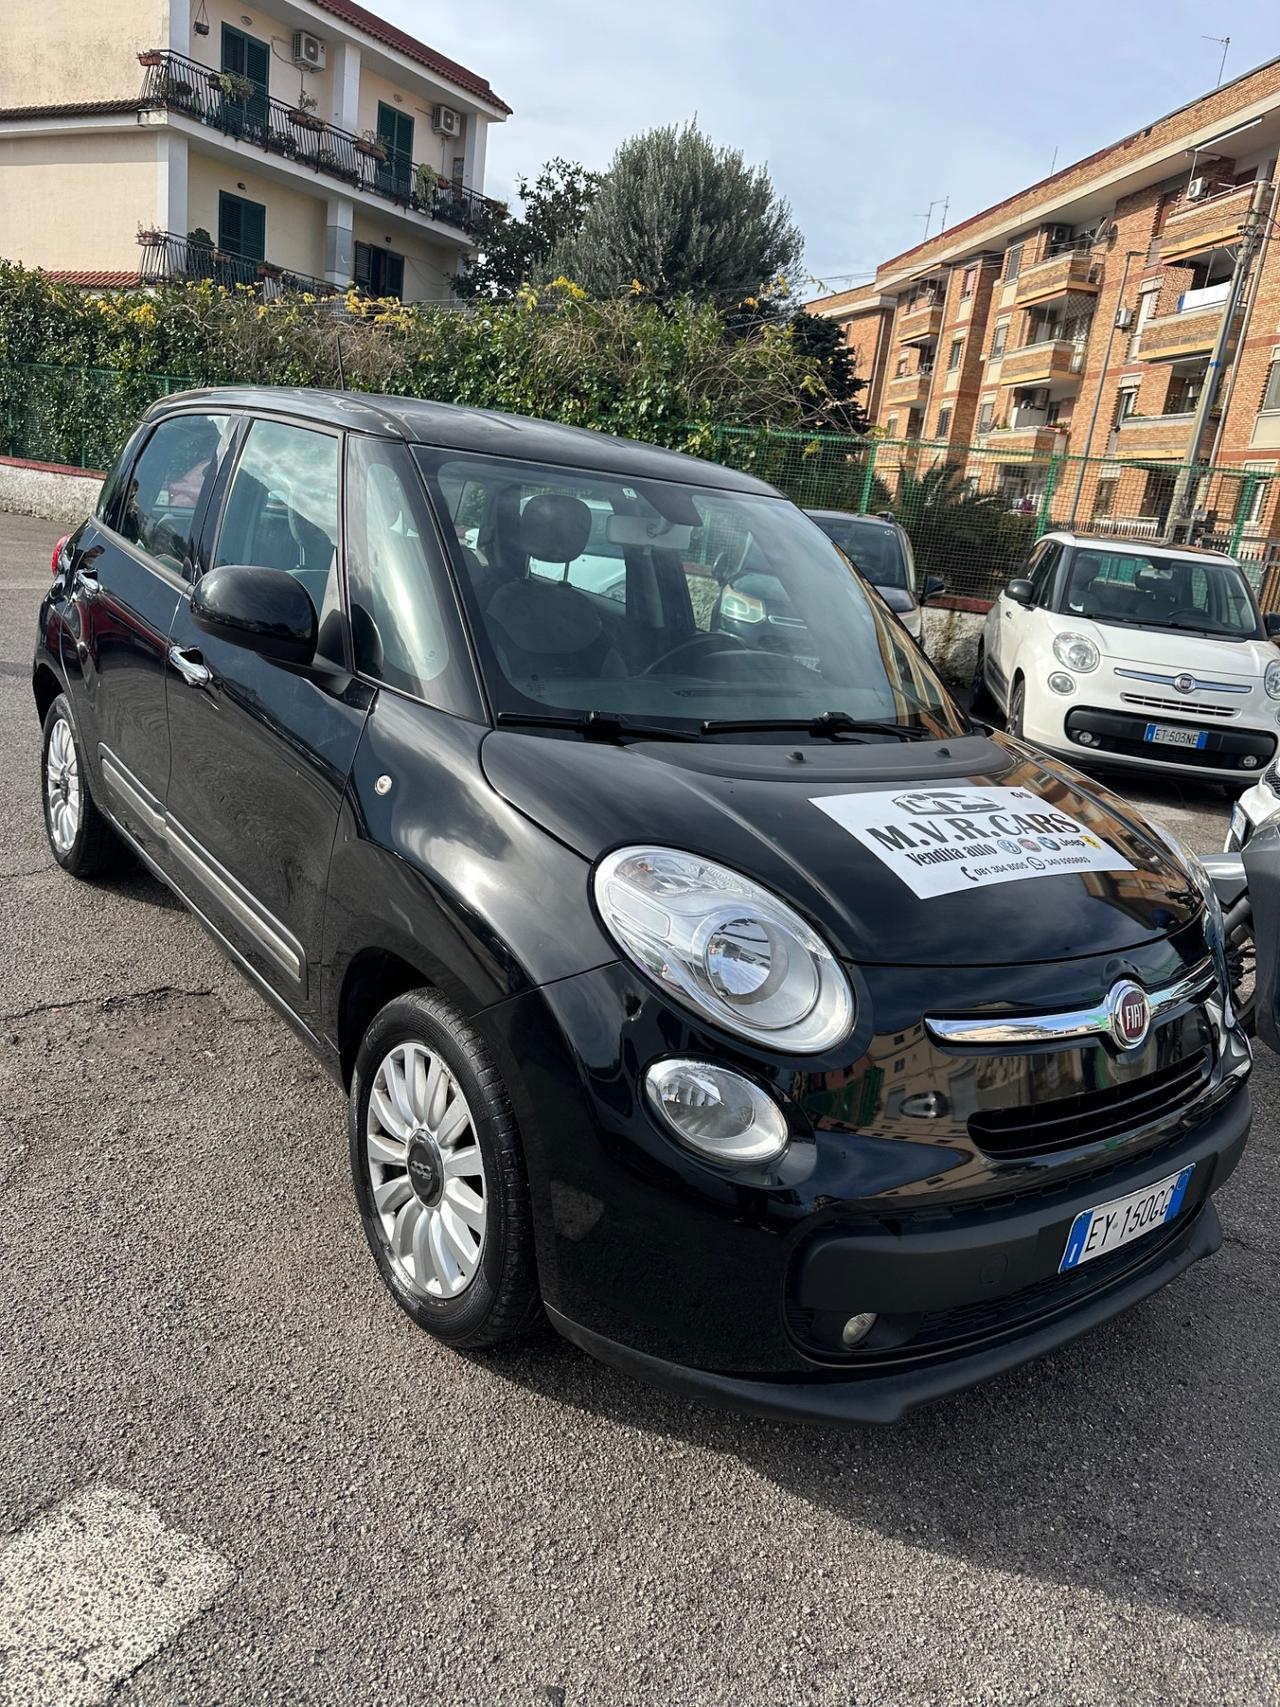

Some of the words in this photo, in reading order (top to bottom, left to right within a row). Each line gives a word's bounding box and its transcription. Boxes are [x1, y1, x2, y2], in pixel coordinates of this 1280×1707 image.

[1155, 729, 1167, 740] ET
[1169, 730, 1198, 745] 503NE
[1058, 837, 1086, 847] Jeep
[905, 846, 967, 867] Vendita
[962, 843, 997, 857] auto
[974, 867, 992, 876] 081
[1125, 1003, 1144, 1030] FIAT
[1084, 1211, 1117, 1253] EY
